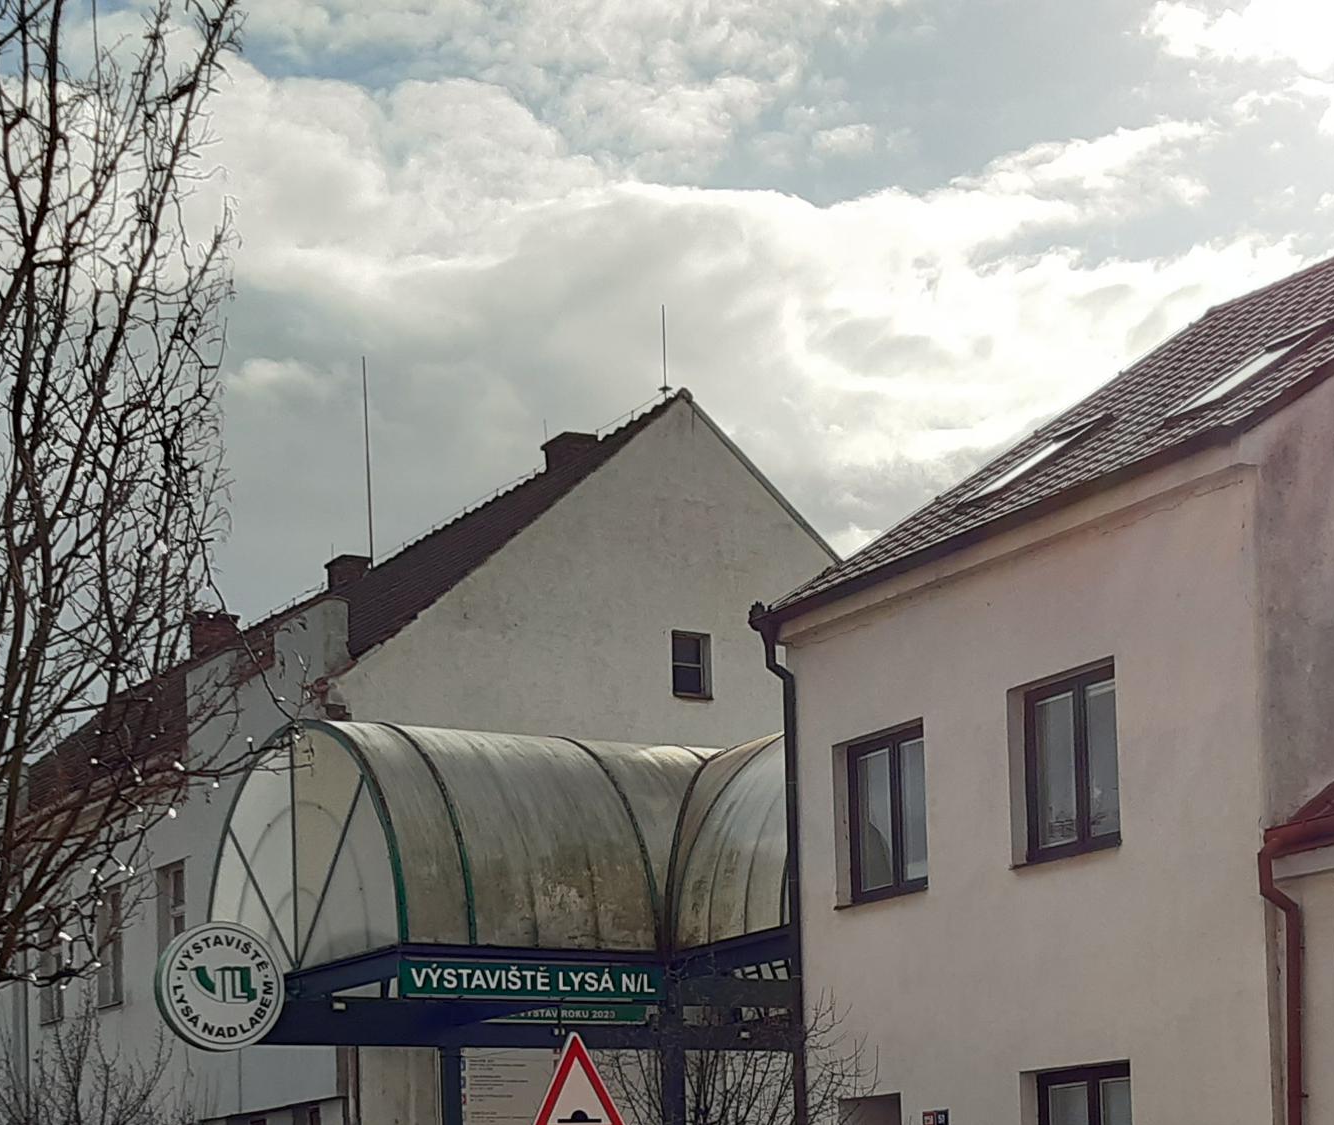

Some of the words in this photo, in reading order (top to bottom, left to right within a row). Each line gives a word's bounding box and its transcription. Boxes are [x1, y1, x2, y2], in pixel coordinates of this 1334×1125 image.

[175, 934, 269, 973] VÝSTAVIŠTĚ
[410, 963, 551, 991] VÝSTAVIŠTĚ
[557, 968, 615, 992] LYSÁ
[620, 973, 657, 993] N/L
[172, 983, 201, 1028] LYSÁ
[201, 1021, 239, 1039] NAD
[237, 980, 275, 1034] LABEM
[560, 1009, 589, 1018] ROKU
